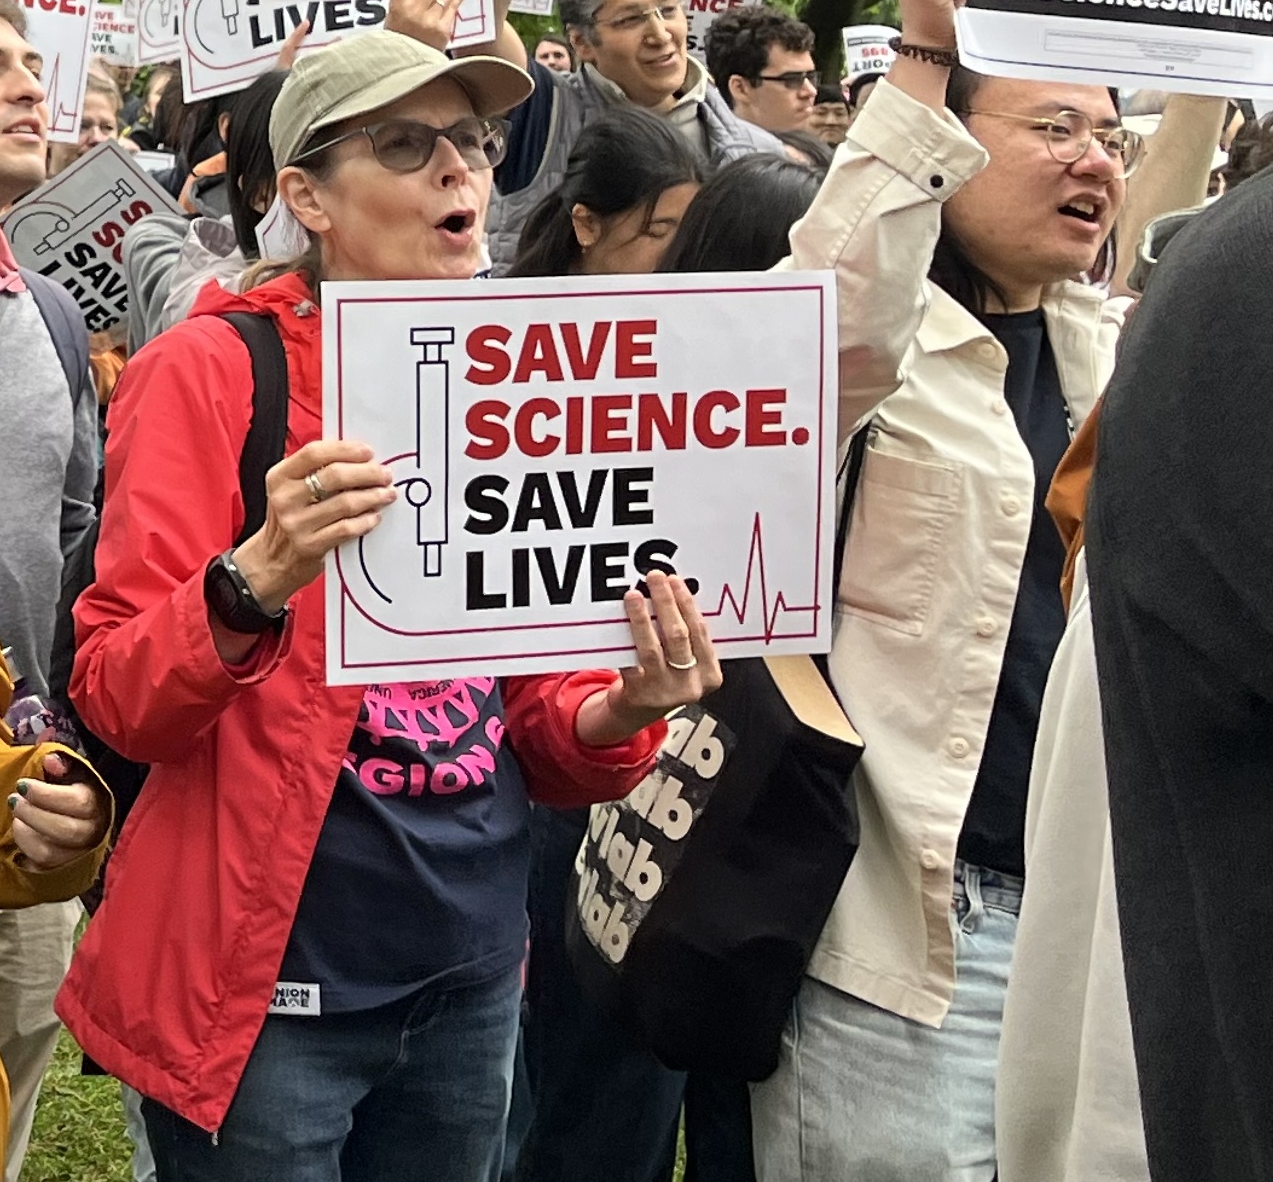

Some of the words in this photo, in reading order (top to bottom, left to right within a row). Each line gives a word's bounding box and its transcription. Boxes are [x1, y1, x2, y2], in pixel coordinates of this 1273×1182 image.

[91, 44, 119, 55] VES.
[94, 23, 135, 34] IENCE
[464, 320, 657, 385] SAVE
[464, 388, 810, 461] SCIENCE.
[463, 466, 654, 535] SAVE
[465, 538, 699, 611] LIVES.
[343, 744, 496, 796] GION
[275, 987, 310, 998] NION
